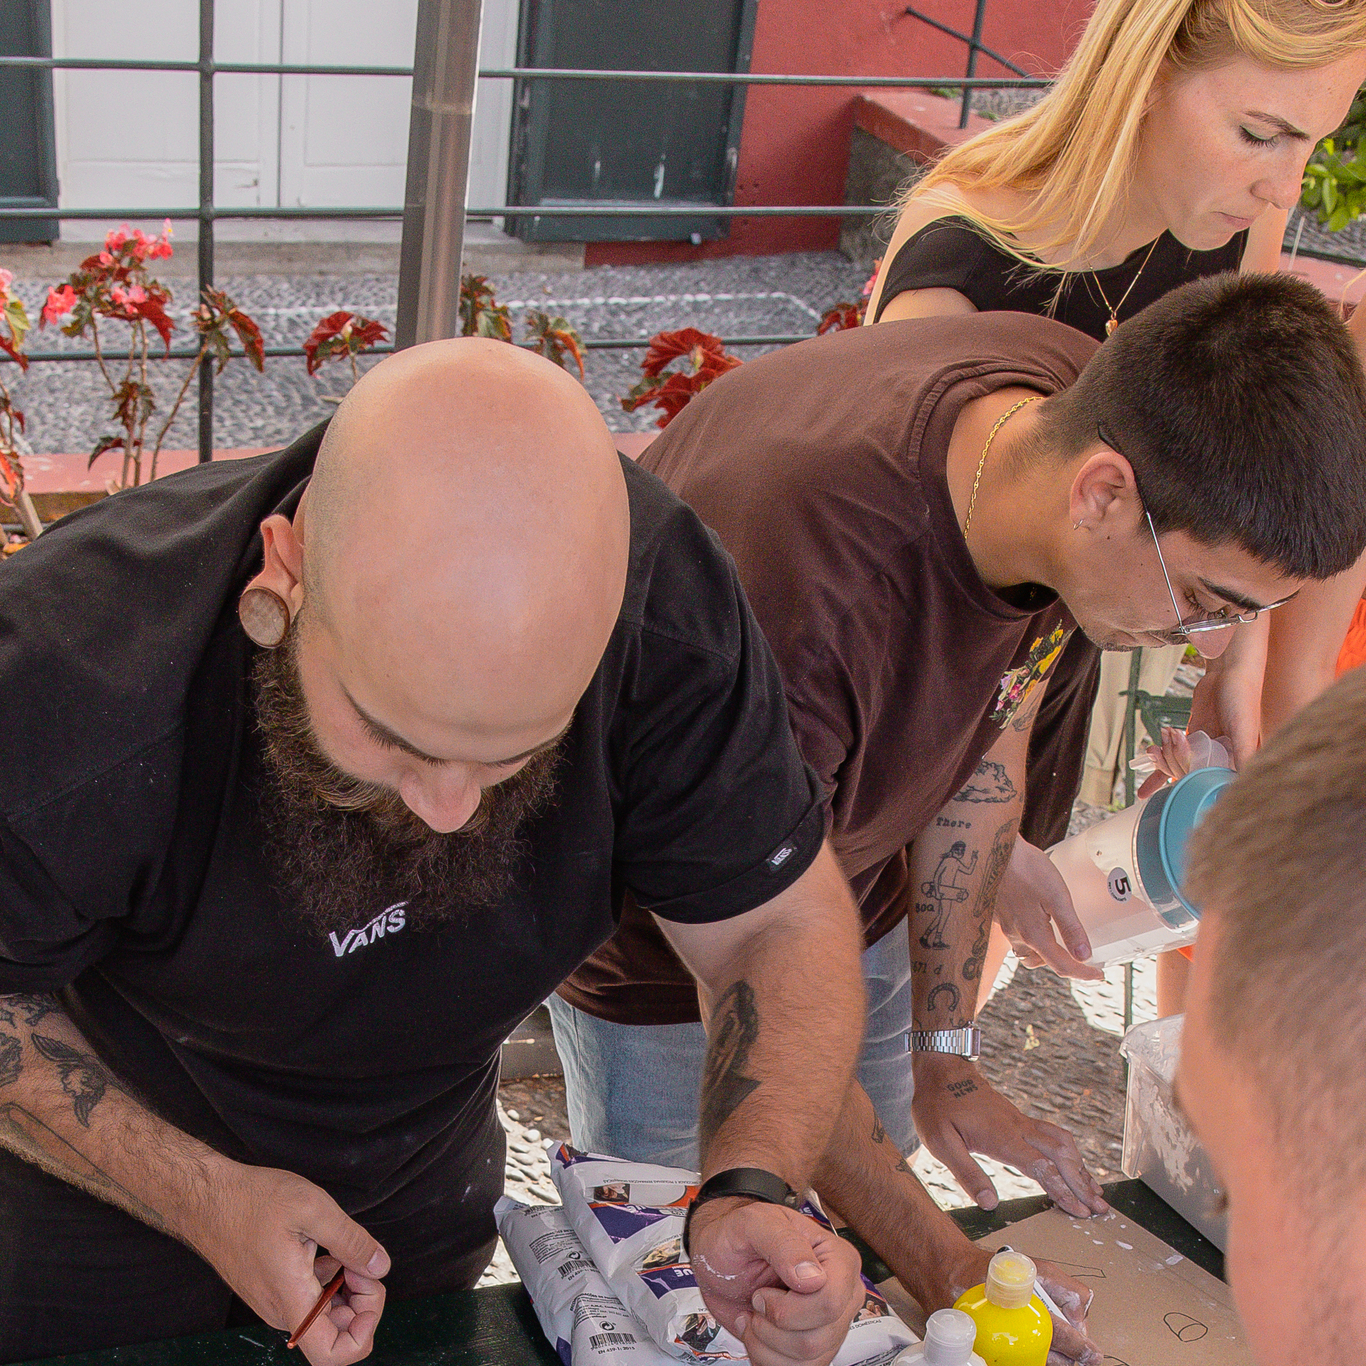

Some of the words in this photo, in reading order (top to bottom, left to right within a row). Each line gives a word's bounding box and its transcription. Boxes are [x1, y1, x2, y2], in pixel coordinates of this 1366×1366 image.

[935, 816, 972, 829] There
[1115, 876, 1131, 895] 5
[329, 901, 409, 957] VANS
[947, 1078, 975, 1092] GOOD
[953, 1084, 980, 1099] NEWS
